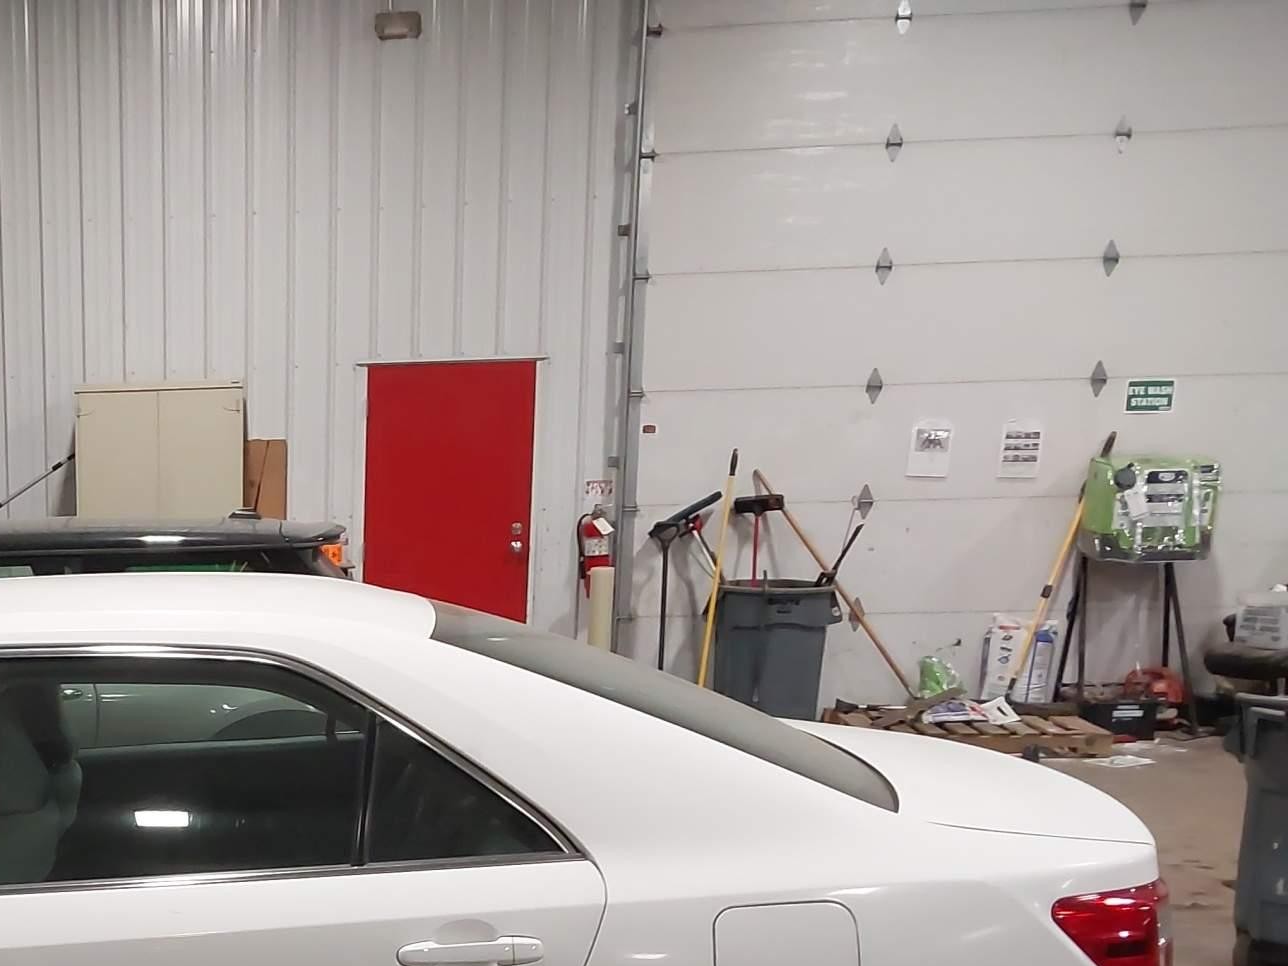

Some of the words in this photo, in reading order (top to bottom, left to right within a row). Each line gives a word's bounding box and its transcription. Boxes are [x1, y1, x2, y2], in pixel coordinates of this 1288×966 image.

[1128, 386, 1145, 395] EYE
[1147, 386, 1173, 395] WASH
[1130, 397, 1169, 406] STATION
